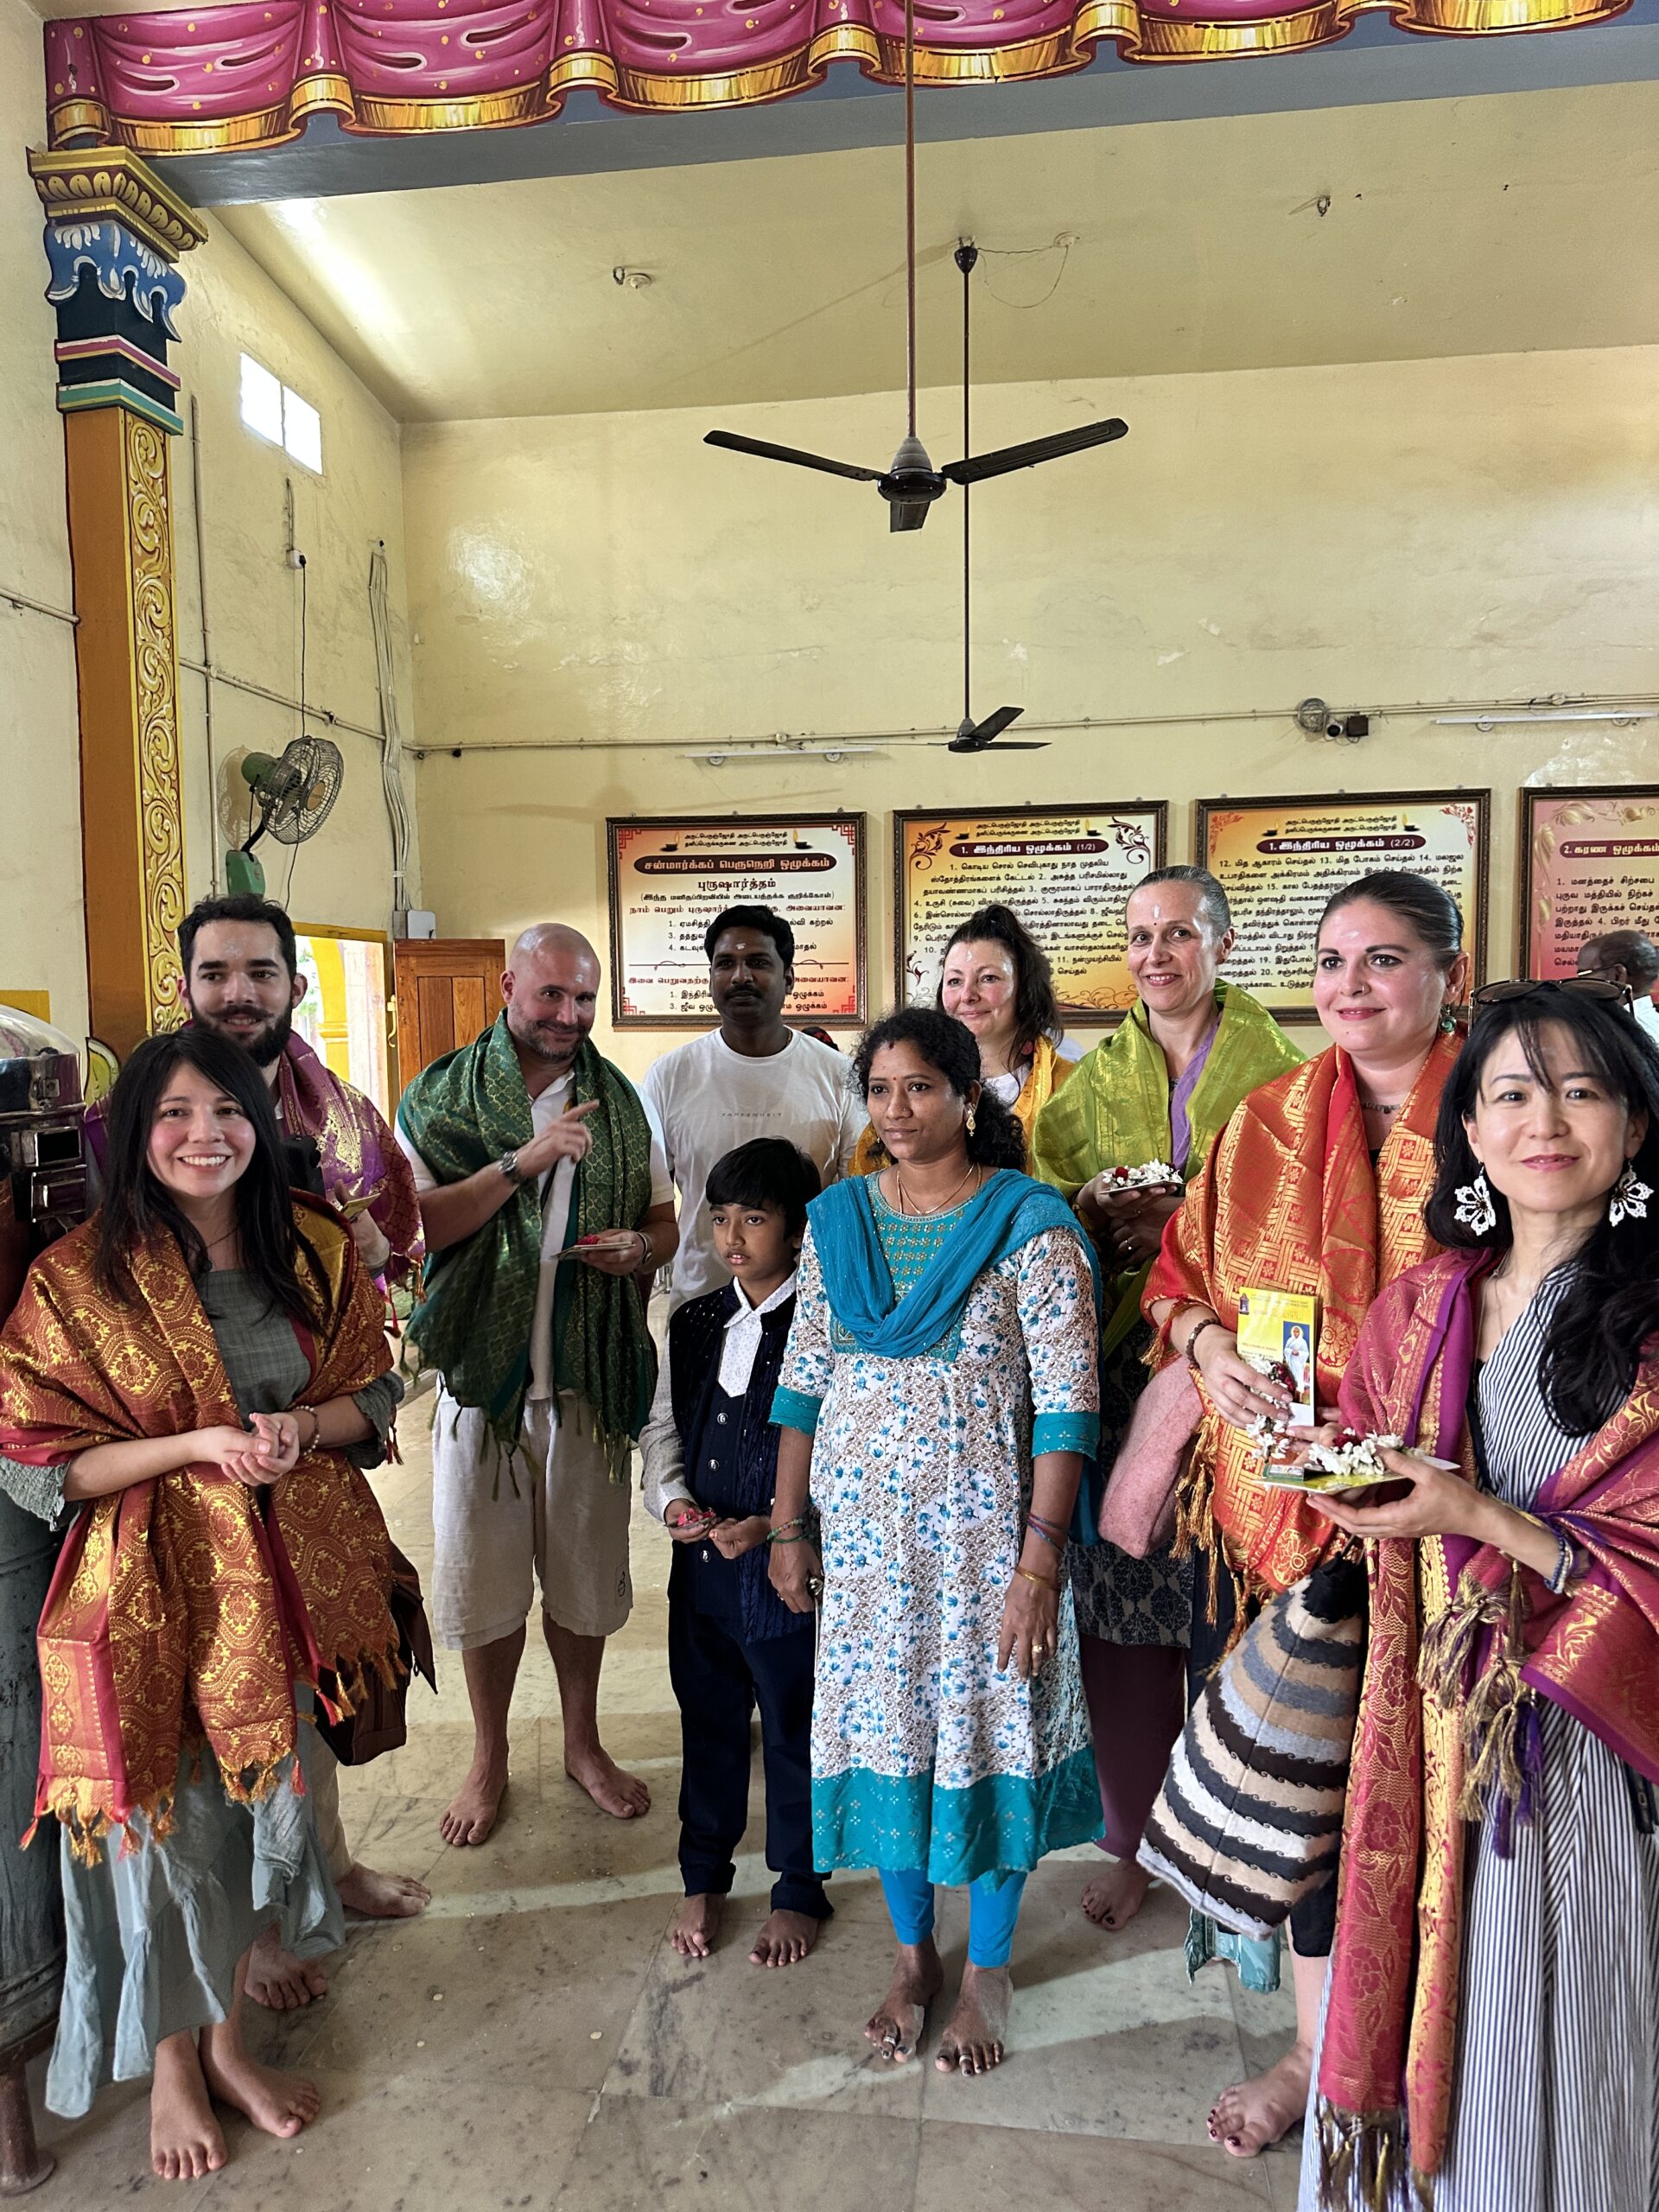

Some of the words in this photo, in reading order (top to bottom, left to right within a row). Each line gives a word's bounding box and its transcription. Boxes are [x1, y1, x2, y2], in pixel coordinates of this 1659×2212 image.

[974, 844, 1020, 855] இந்திரிய
[1026, 842, 1071, 854] ஒழுக்கம்
[1279, 841, 1330, 851] இந்திரிய
[1335, 838, 1384, 850] ஒழுக்கம்
[1390, 839, 1414, 848] (2/2)
[1574, 845, 1607, 855] கரண
[645, 860, 714, 870] சன்மார்க்கப்
[720, 859, 775, 870] பெருநெறி
[780, 857, 830, 870] ஒழுக்கம்
[698, 878, 776, 891] புருஷார்த்தம்
[630, 906, 650, 914] நாம்
[654, 906, 683, 914] பெறும்
[793, 990, 824, 1000] ஒழுக்கம்
[796, 1002, 827, 1011] ஒழுக்கம்
